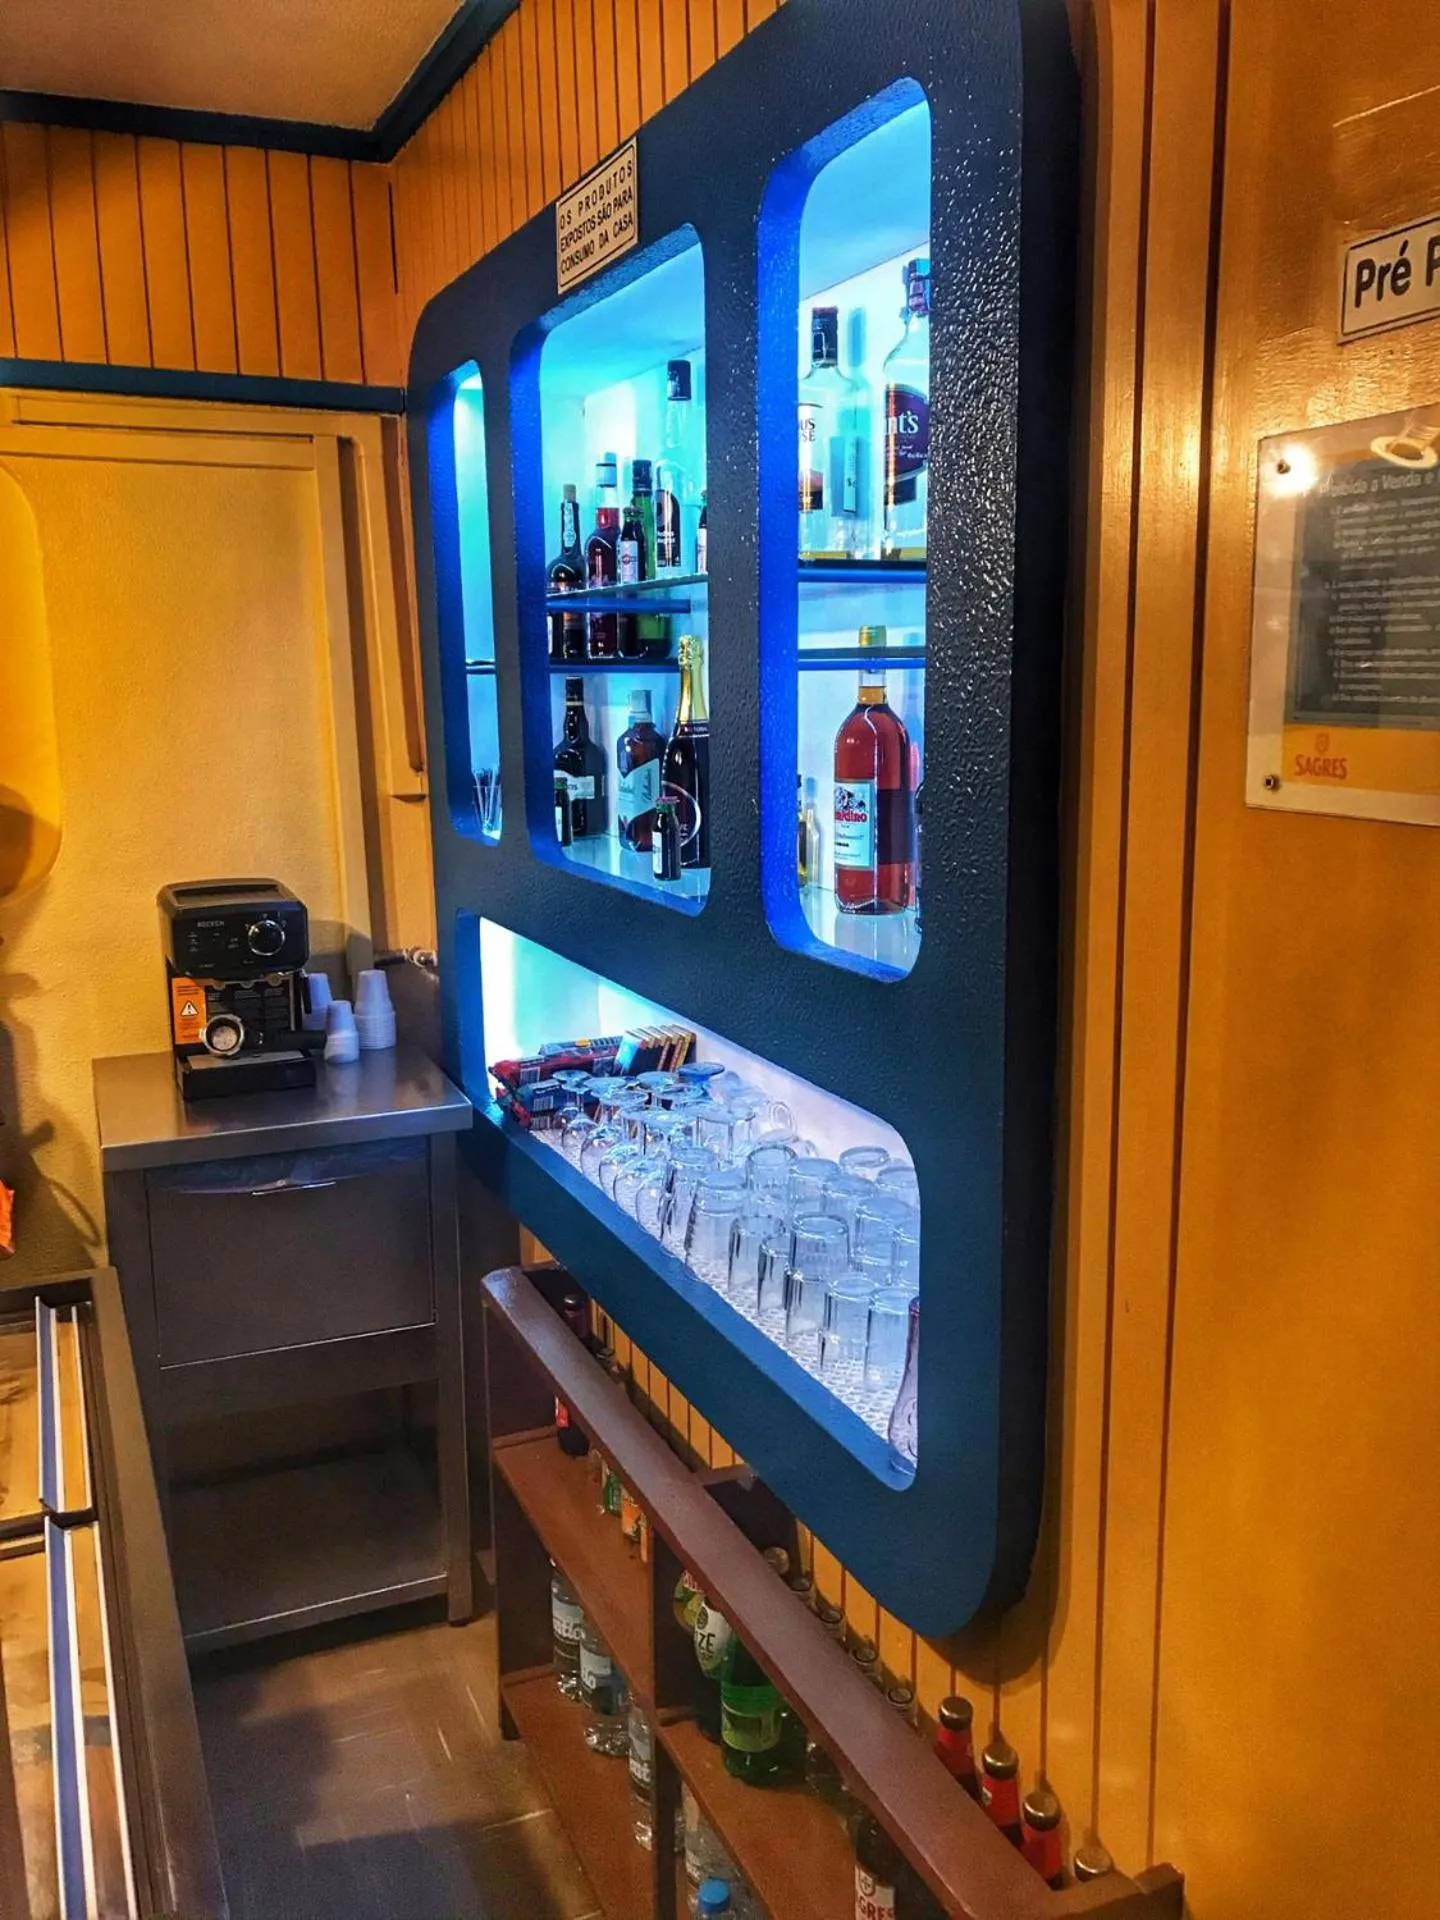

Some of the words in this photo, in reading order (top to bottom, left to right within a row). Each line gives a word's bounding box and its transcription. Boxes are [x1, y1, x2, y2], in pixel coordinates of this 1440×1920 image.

[560, 209, 572, 230] OS
[578, 159, 633, 217] PRODUTOS
[560, 215, 596, 253] EXPOSTOS
[597, 203, 612, 227] SÃO
[612, 185, 633, 213] PARA
[560, 239, 596, 275] CONSUMO
[599, 229, 610, 250] DA
[612, 211, 634, 238] CASA
[1354, 239, 1412, 309] Pré
[1294, 754, 1348, 780] SAGRES
